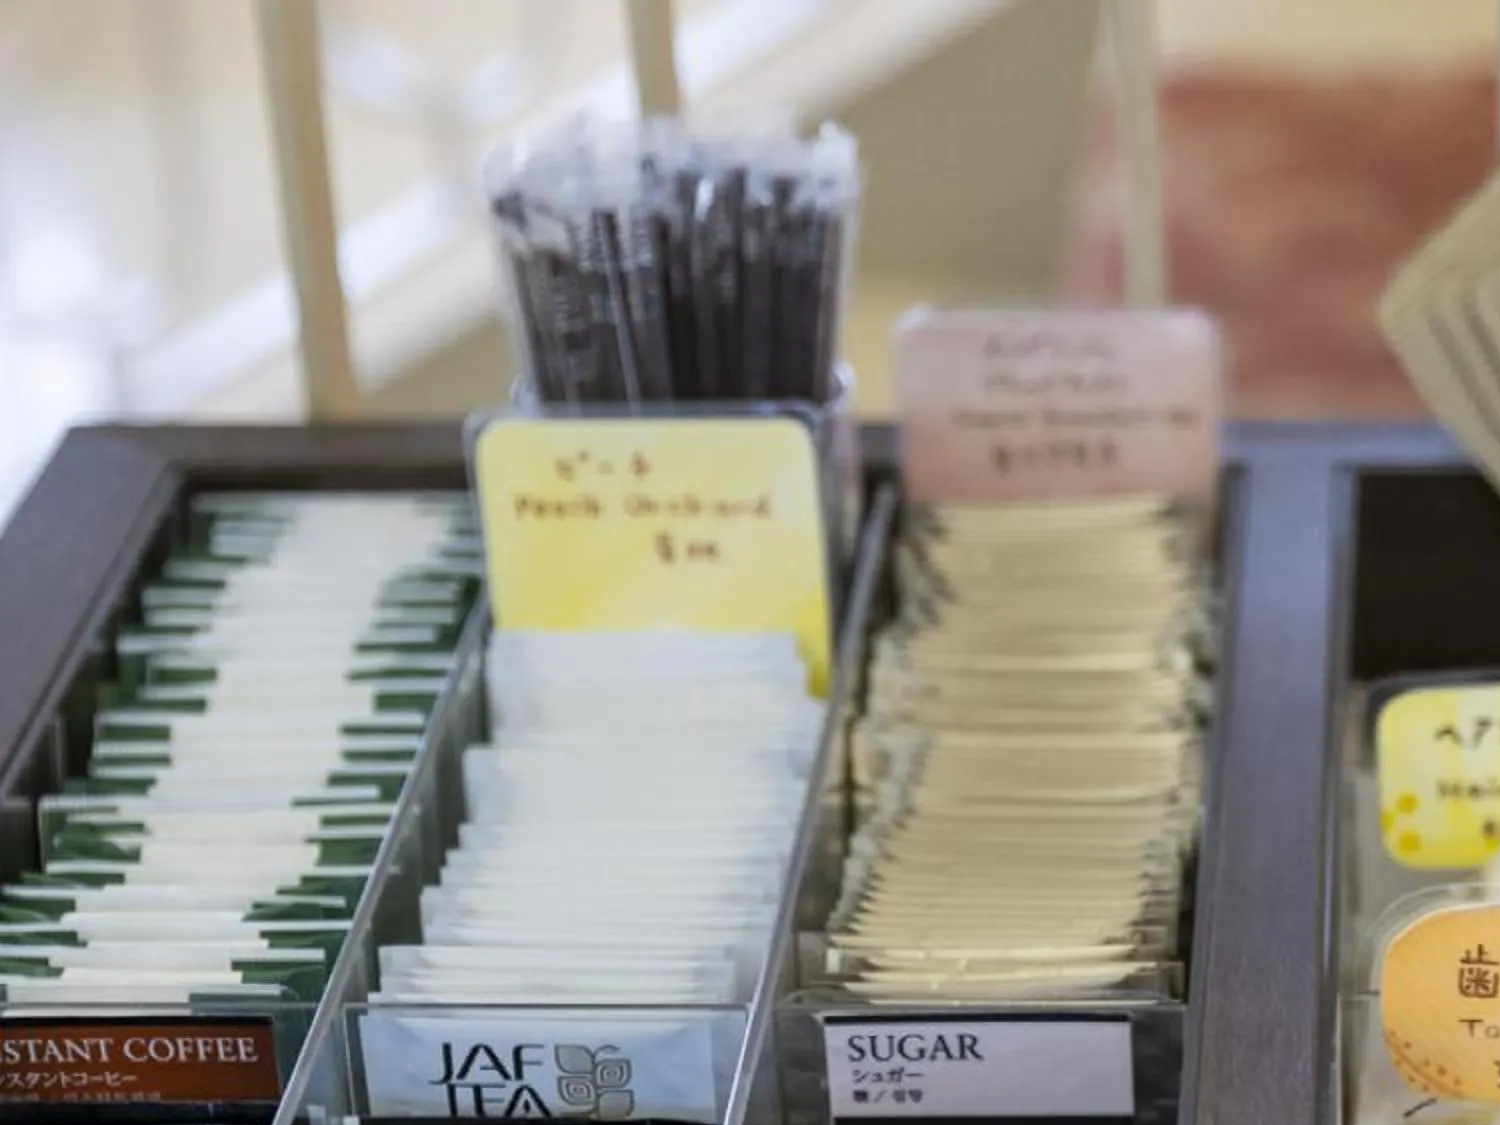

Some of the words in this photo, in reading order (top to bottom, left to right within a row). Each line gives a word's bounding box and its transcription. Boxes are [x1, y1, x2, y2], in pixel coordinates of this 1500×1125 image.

[0, 1036, 114, 1064] STANT
[123, 1036, 259, 1064] COFFEE
[847, 1034, 985, 1063] SUGAR
[429, 1042, 545, 1085] JAF
[852, 1067, 924, 1083] シュガー
